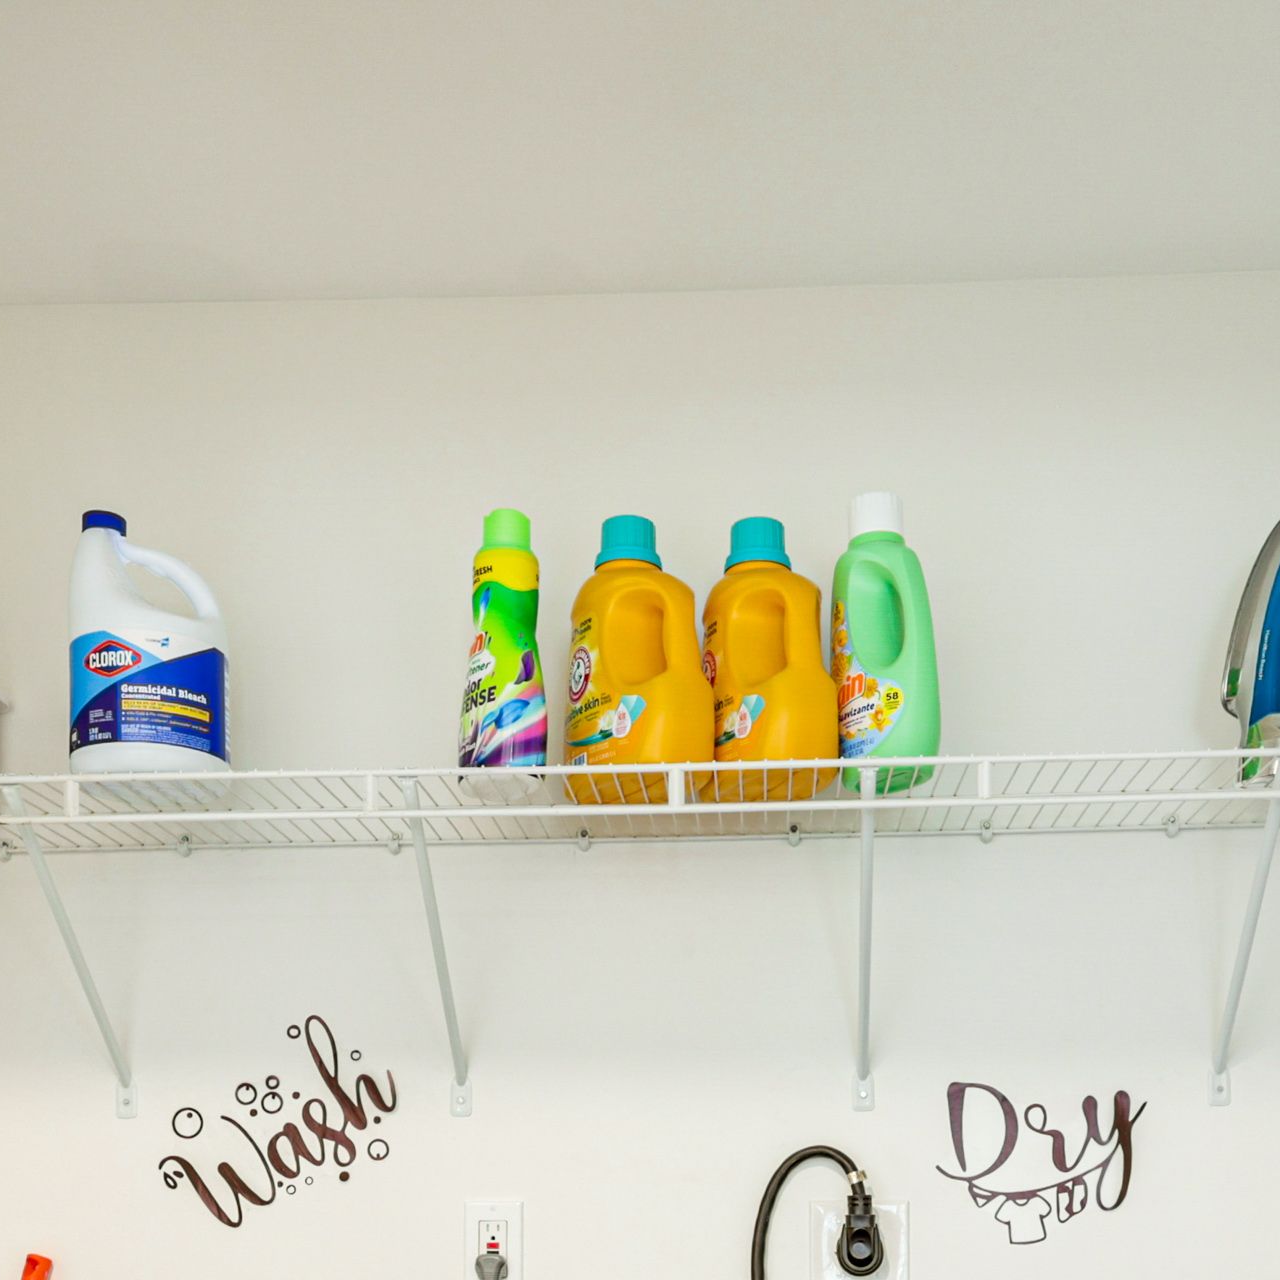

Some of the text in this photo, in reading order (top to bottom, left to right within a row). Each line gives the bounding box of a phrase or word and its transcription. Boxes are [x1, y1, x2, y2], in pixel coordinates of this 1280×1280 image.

[89, 650, 133, 669] CLOROX
[121, 683, 207, 704] Germicidal Bleach
[886, 691, 899, 701] 58
[584, 697, 600, 712] skin
[839, 702, 875, 722] uavizante
[158, 1015, 397, 1228] Wash
[936, 1081, 1147, 1211] Dry
